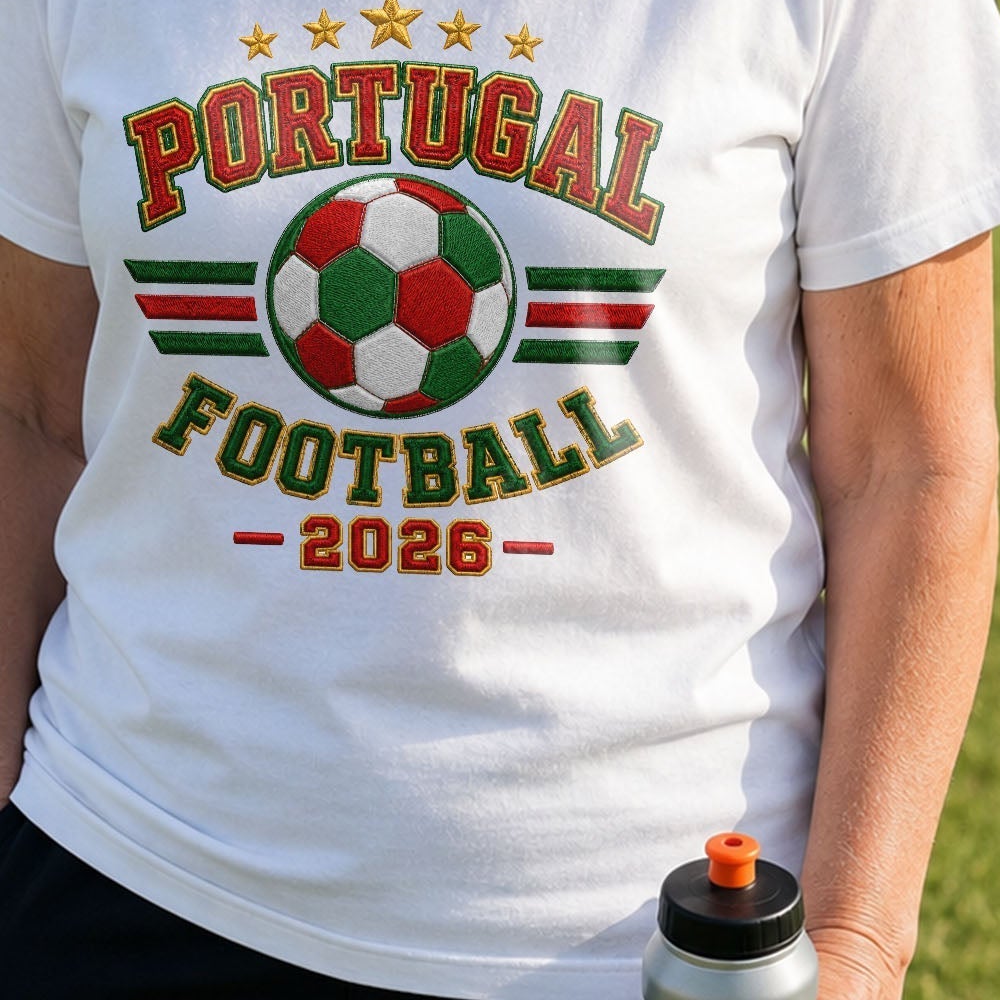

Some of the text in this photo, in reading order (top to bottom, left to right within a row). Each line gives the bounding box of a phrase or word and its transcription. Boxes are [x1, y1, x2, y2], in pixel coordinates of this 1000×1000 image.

[123, 60, 665, 246] PORTUGAL
[152, 372, 645, 509] FOOTBALL
[299, 513, 494, 577] 2026
